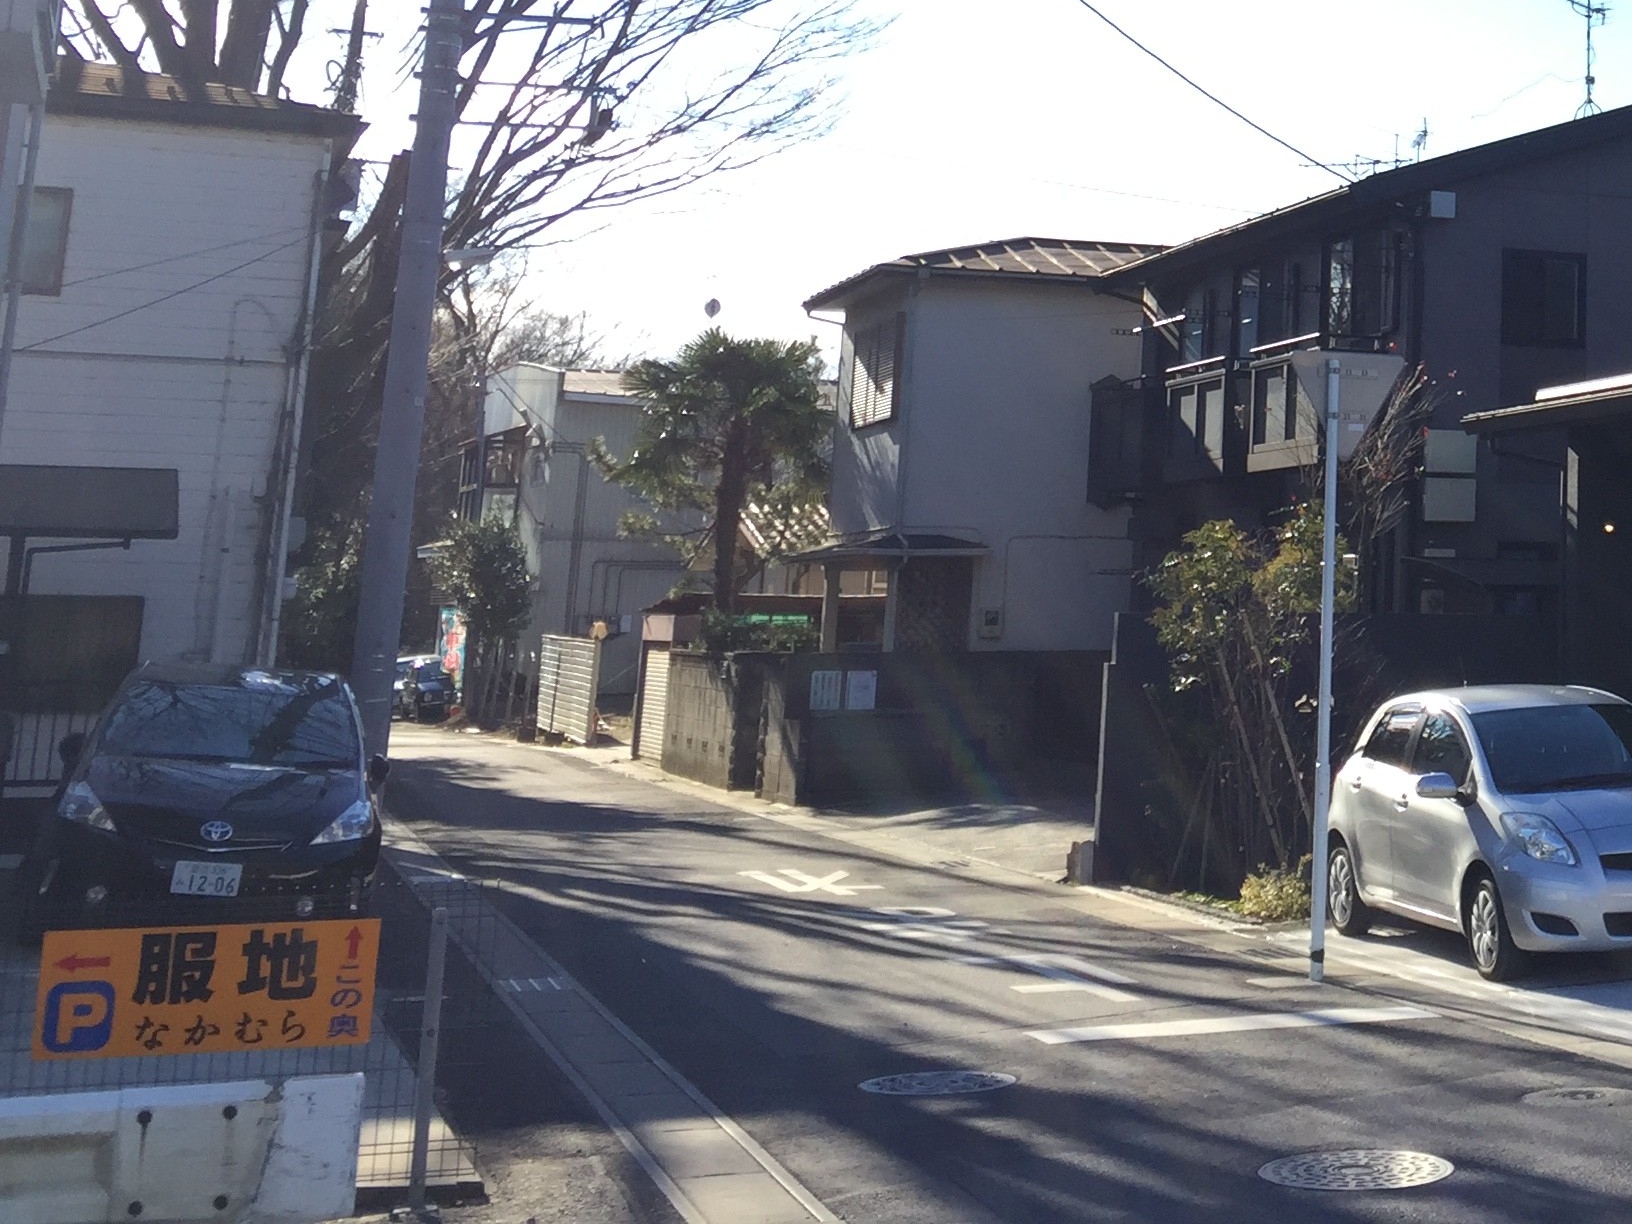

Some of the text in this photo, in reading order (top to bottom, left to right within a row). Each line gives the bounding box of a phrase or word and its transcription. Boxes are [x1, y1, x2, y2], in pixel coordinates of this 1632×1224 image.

[131, 928, 319, 1006] 服地
[325, 963, 362, 1038] この奥
[135, 1010, 307, 1052] なかむら
